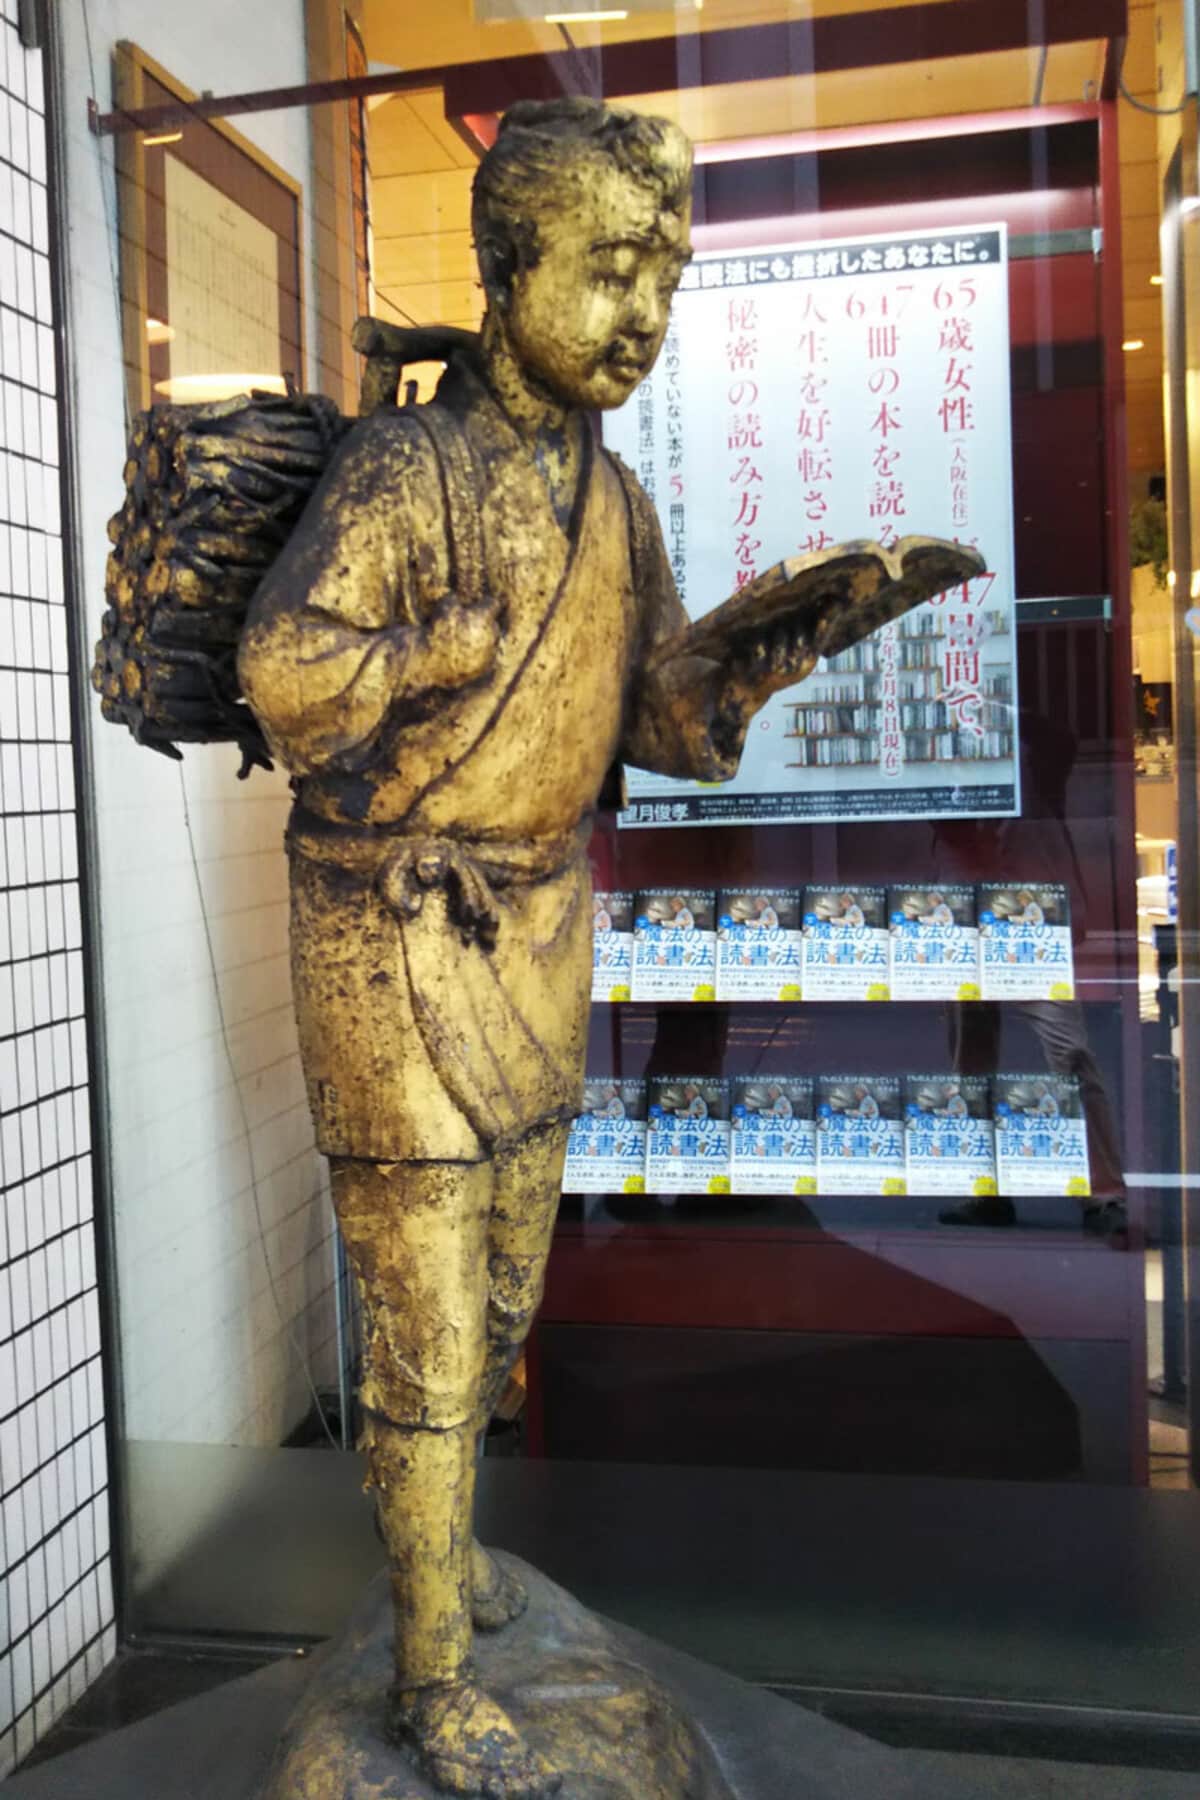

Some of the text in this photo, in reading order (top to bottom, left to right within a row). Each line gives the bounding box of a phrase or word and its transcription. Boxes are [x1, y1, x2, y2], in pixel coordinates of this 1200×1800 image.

[797, 293, 835, 552] 人生を好転させ
[645, 924, 702, 943] 魔法の
[728, 924, 787, 943] 魔法の
[813, 921, 873, 940] 魔法の
[901, 921, 961, 940] 魔法の
[991, 920, 1054, 940] 魔法の
[636, 944, 713, 967] 読書法
[721, 944, 799, 967] 読書法
[806, 942, 888, 965] 読書法
[894, 942, 976, 965] 読書法
[984, 941, 1067, 965] 読書法
[576, 1116, 633, 1133] 魔法の
[657, 1115, 716, 1133] 魔法の
[742, 1115, 801, 1133] 魔法の
[828, 1115, 888, 1133] 魔法の
[916, 1115, 978, 1133] 魔法の
[1006, 1115, 1069, 1133] 魔法の
[567, 1134, 645, 1157] 読書法
[650, 1134, 729, 1157] 読書法
[735, 1134, 815, 1157] 読書法
[820, 1134, 901, 1158] 読書法
[908, 1134, 993, 1158] 読書法
[1000, 1134, 1084, 1158] 読書法
